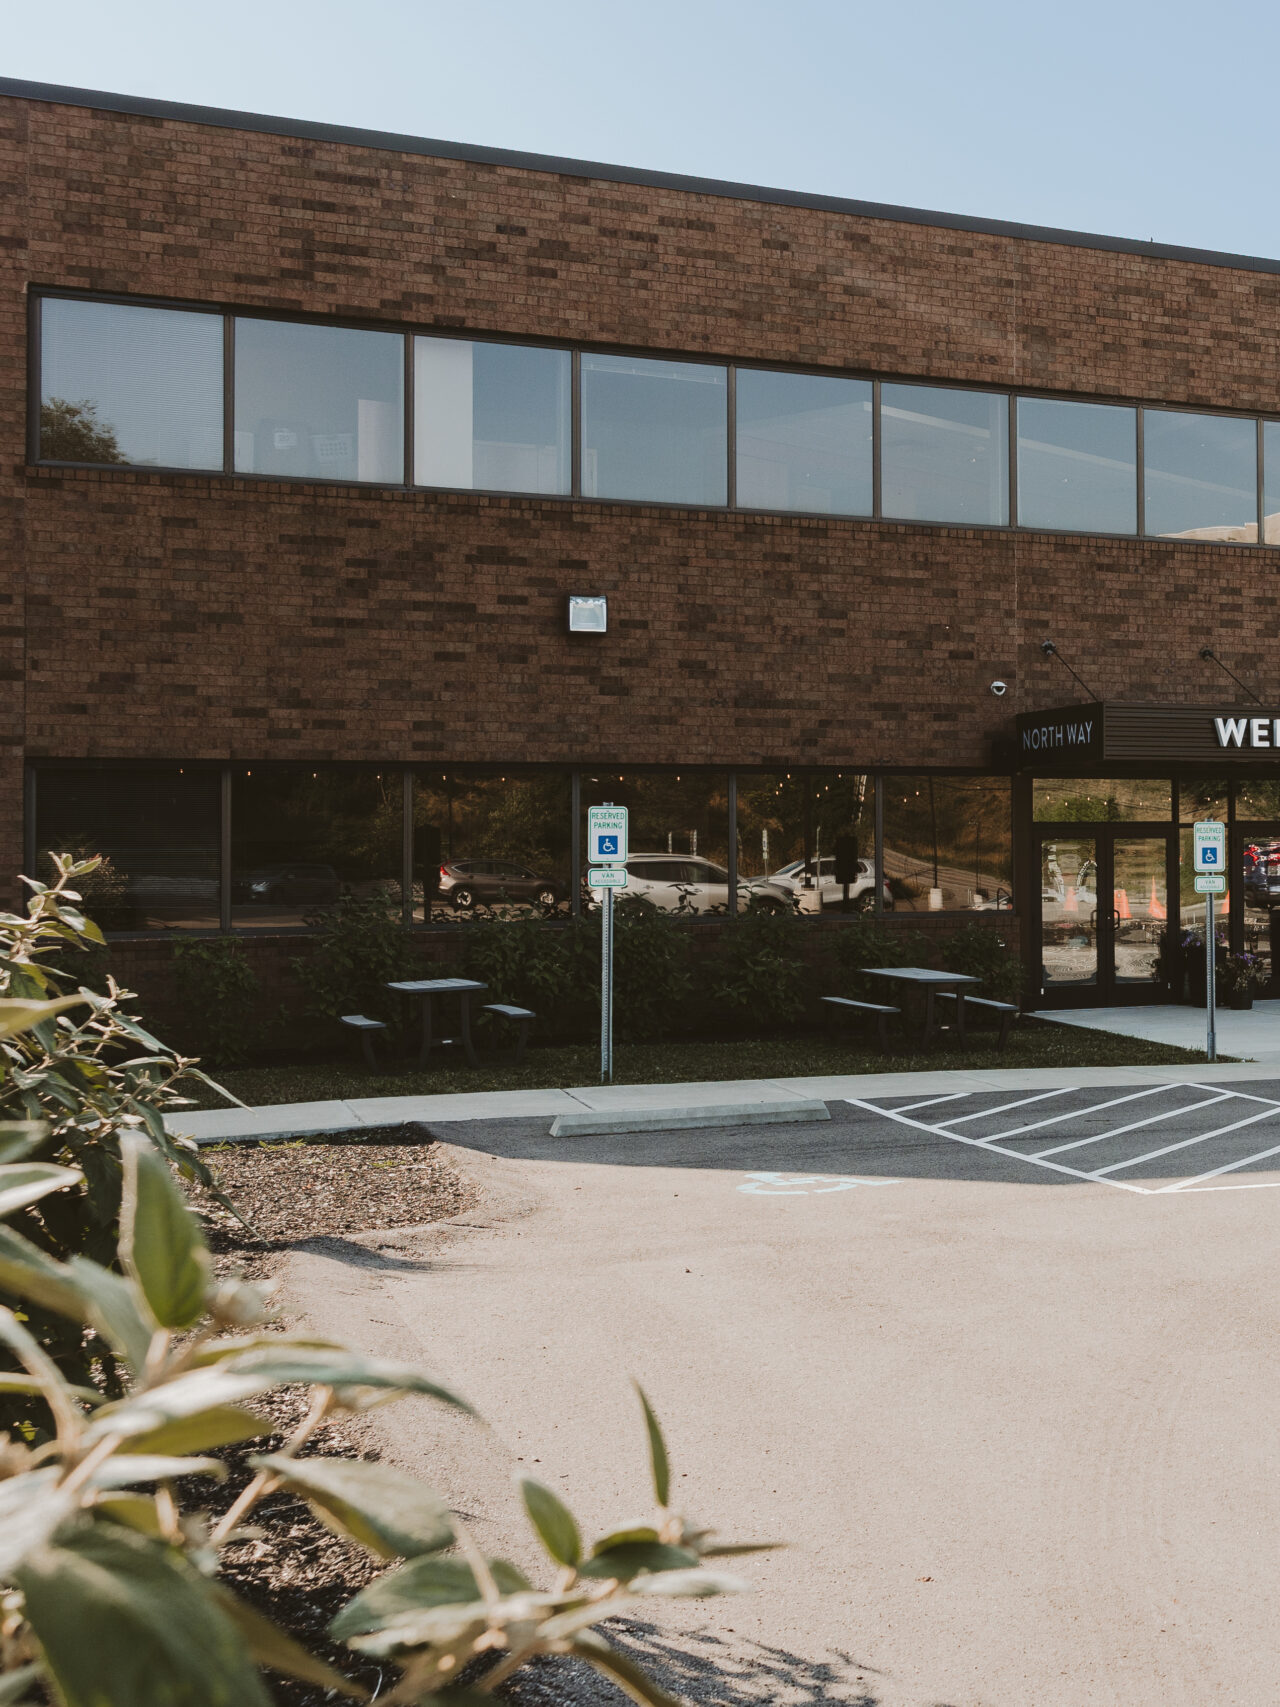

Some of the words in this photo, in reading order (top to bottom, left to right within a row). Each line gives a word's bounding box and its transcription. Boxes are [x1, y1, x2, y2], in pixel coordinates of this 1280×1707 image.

[1022, 724, 1064, 751] NORTH
[1066, 720, 1093, 745] WAY
[591, 812, 625, 820] RESERVED
[593, 822, 623, 830] PARKING
